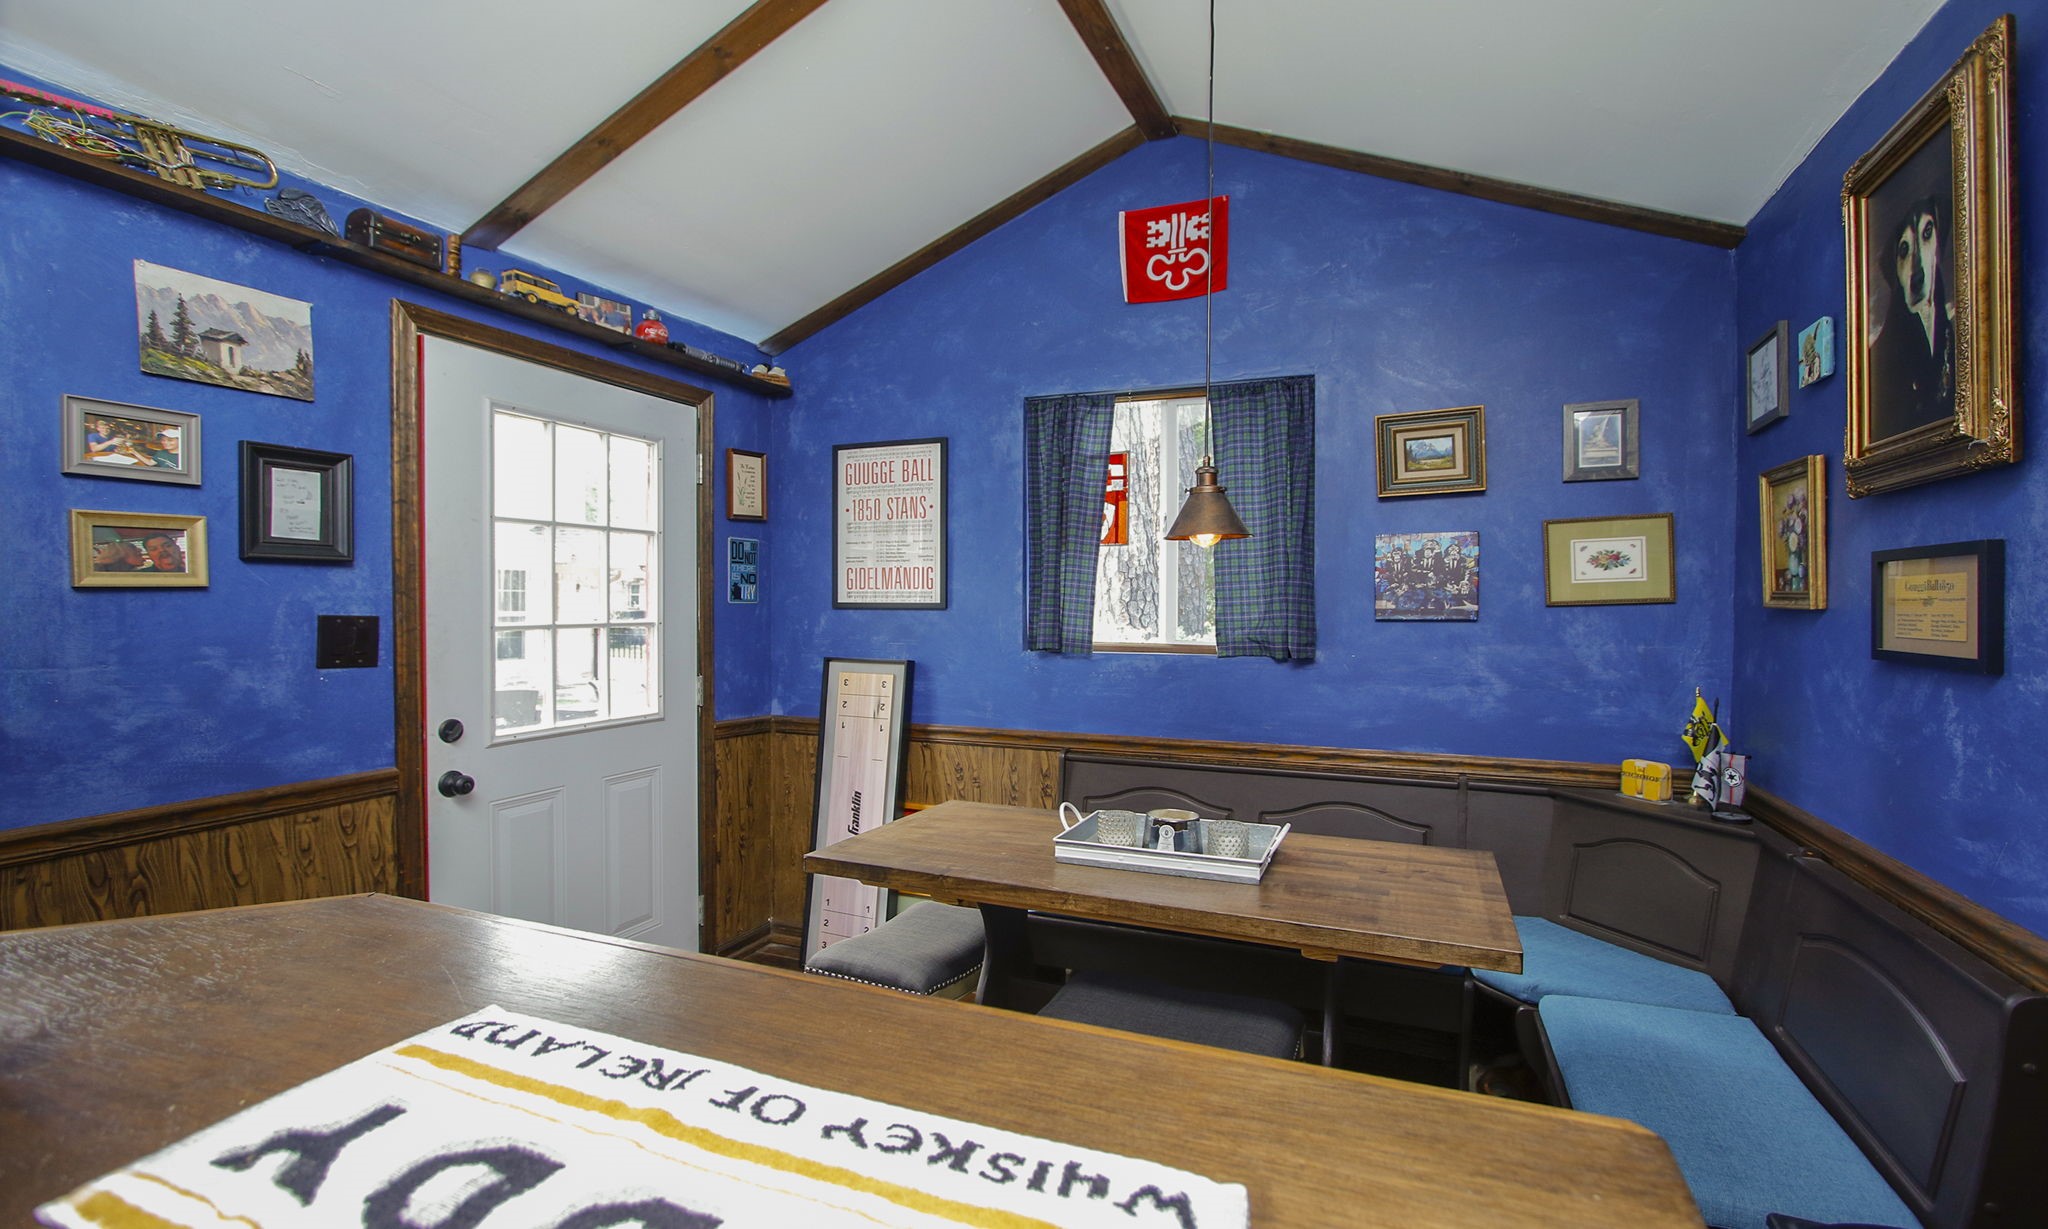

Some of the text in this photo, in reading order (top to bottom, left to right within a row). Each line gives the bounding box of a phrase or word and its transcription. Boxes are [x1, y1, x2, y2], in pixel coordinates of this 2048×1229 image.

[845, 458, 934, 486] GUUGGE BALL
[852, 495, 927, 521] 1850 STANS
[731, 541, 744, 560] DO
[740, 573, 756, 584] NO
[846, 565, 934, 591] GIDELMÄNDIG
[740, 584, 756, 600] TRY
[843, 678, 887, 689] 3 3
[841, 700, 886, 711] 2 2
[825, 898, 870, 913] 1 1
[823, 919, 829, 927] 2
[821, 941, 827, 949] 3
[450, 1021, 1199, 1229] WHISKEY OF IRELAND
